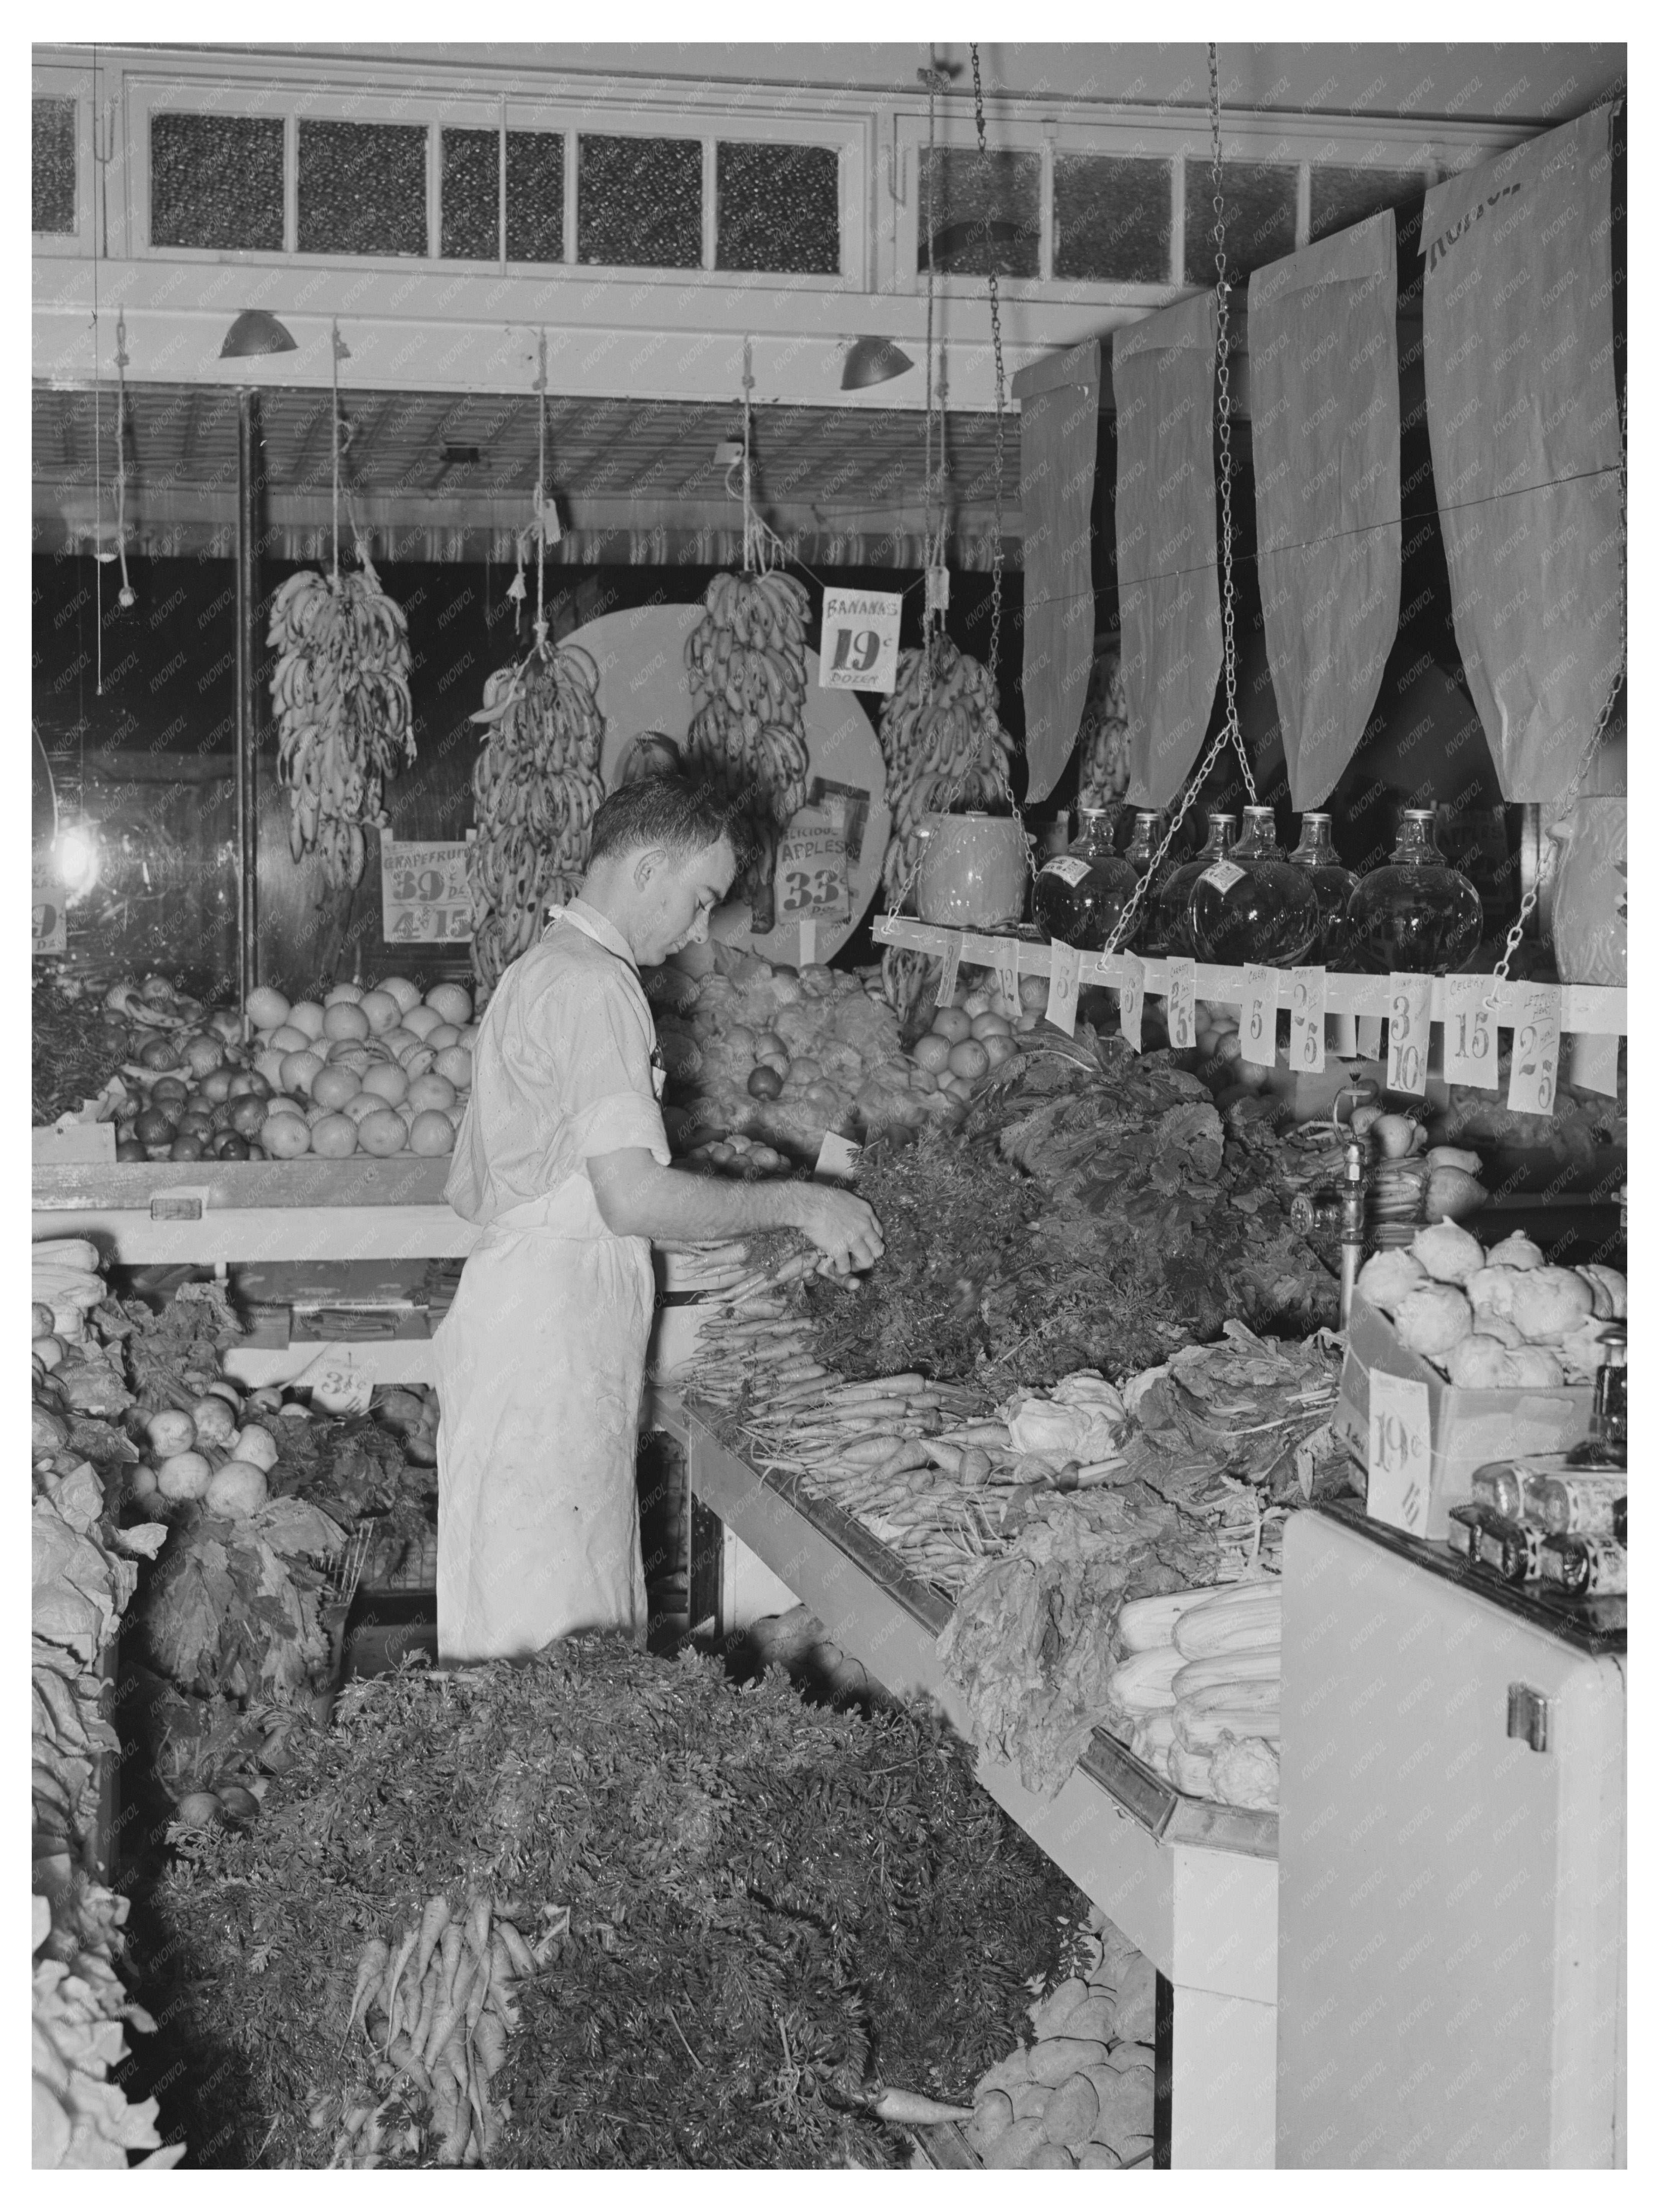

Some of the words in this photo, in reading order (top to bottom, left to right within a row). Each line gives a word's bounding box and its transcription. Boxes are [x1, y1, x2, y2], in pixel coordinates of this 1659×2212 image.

[827, 599, 898, 620] BANANAS
[832, 673, 879, 685] DOZEN
[782, 840, 845, 862] APPLES
[392, 912, 421, 939] 4
[434, 909, 472, 938] 15
[999, 968, 1015, 1001] 12
[1170, 963, 1189, 978] CARROTS
[1248, 969, 1268, 984] CELERY
[1294, 969, 1314, 980] TURNIPS
[1450, 977, 1485, 995] CELERY
[1170, 981, 1179, 1013] 2
[1293, 983, 1307, 1027] 2
[1250, 999, 1263, 1040] 5
[1390, 996, 1410, 1041] 3
[1454, 1010, 1490, 1059] 15
[1304, 1022, 1318, 1064] 5
[1519, 1025, 1537, 1076] 2
[1538, 1059, 1553, 1107] 5
